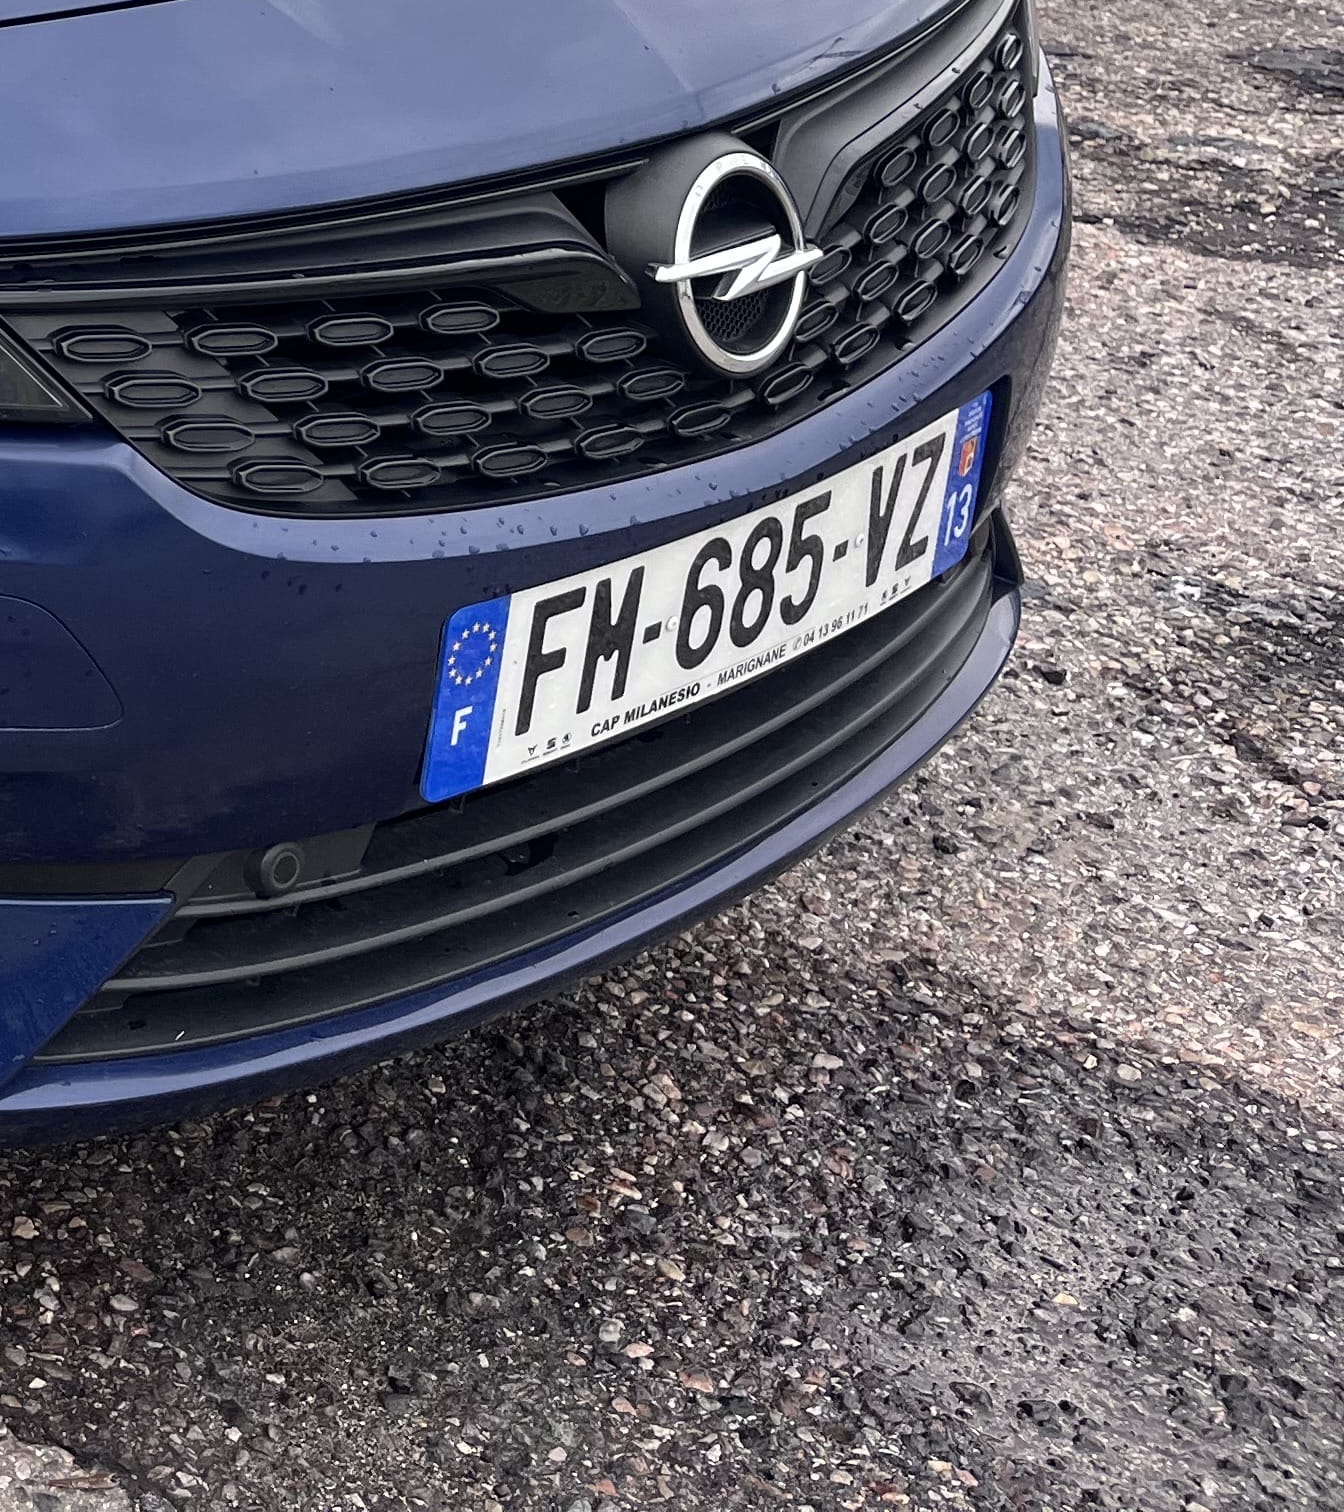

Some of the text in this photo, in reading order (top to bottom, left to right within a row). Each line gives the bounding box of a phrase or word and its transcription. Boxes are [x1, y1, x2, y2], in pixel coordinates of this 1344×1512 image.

[944, 483, 974, 548] 13
[514, 431, 947, 737] FM-685-VZ
[590, 714, 621, 738] CAP
[623, 681, 701, 726] MILANESIO
[716, 644, 788, 687] MARIGNANE
[803, 630, 816, 647] 04
[819, 624, 830, 639] 13
[846, 610, 856, 625] 11
[858, 602, 869, 619] 71
[449, 706, 474, 747] F
